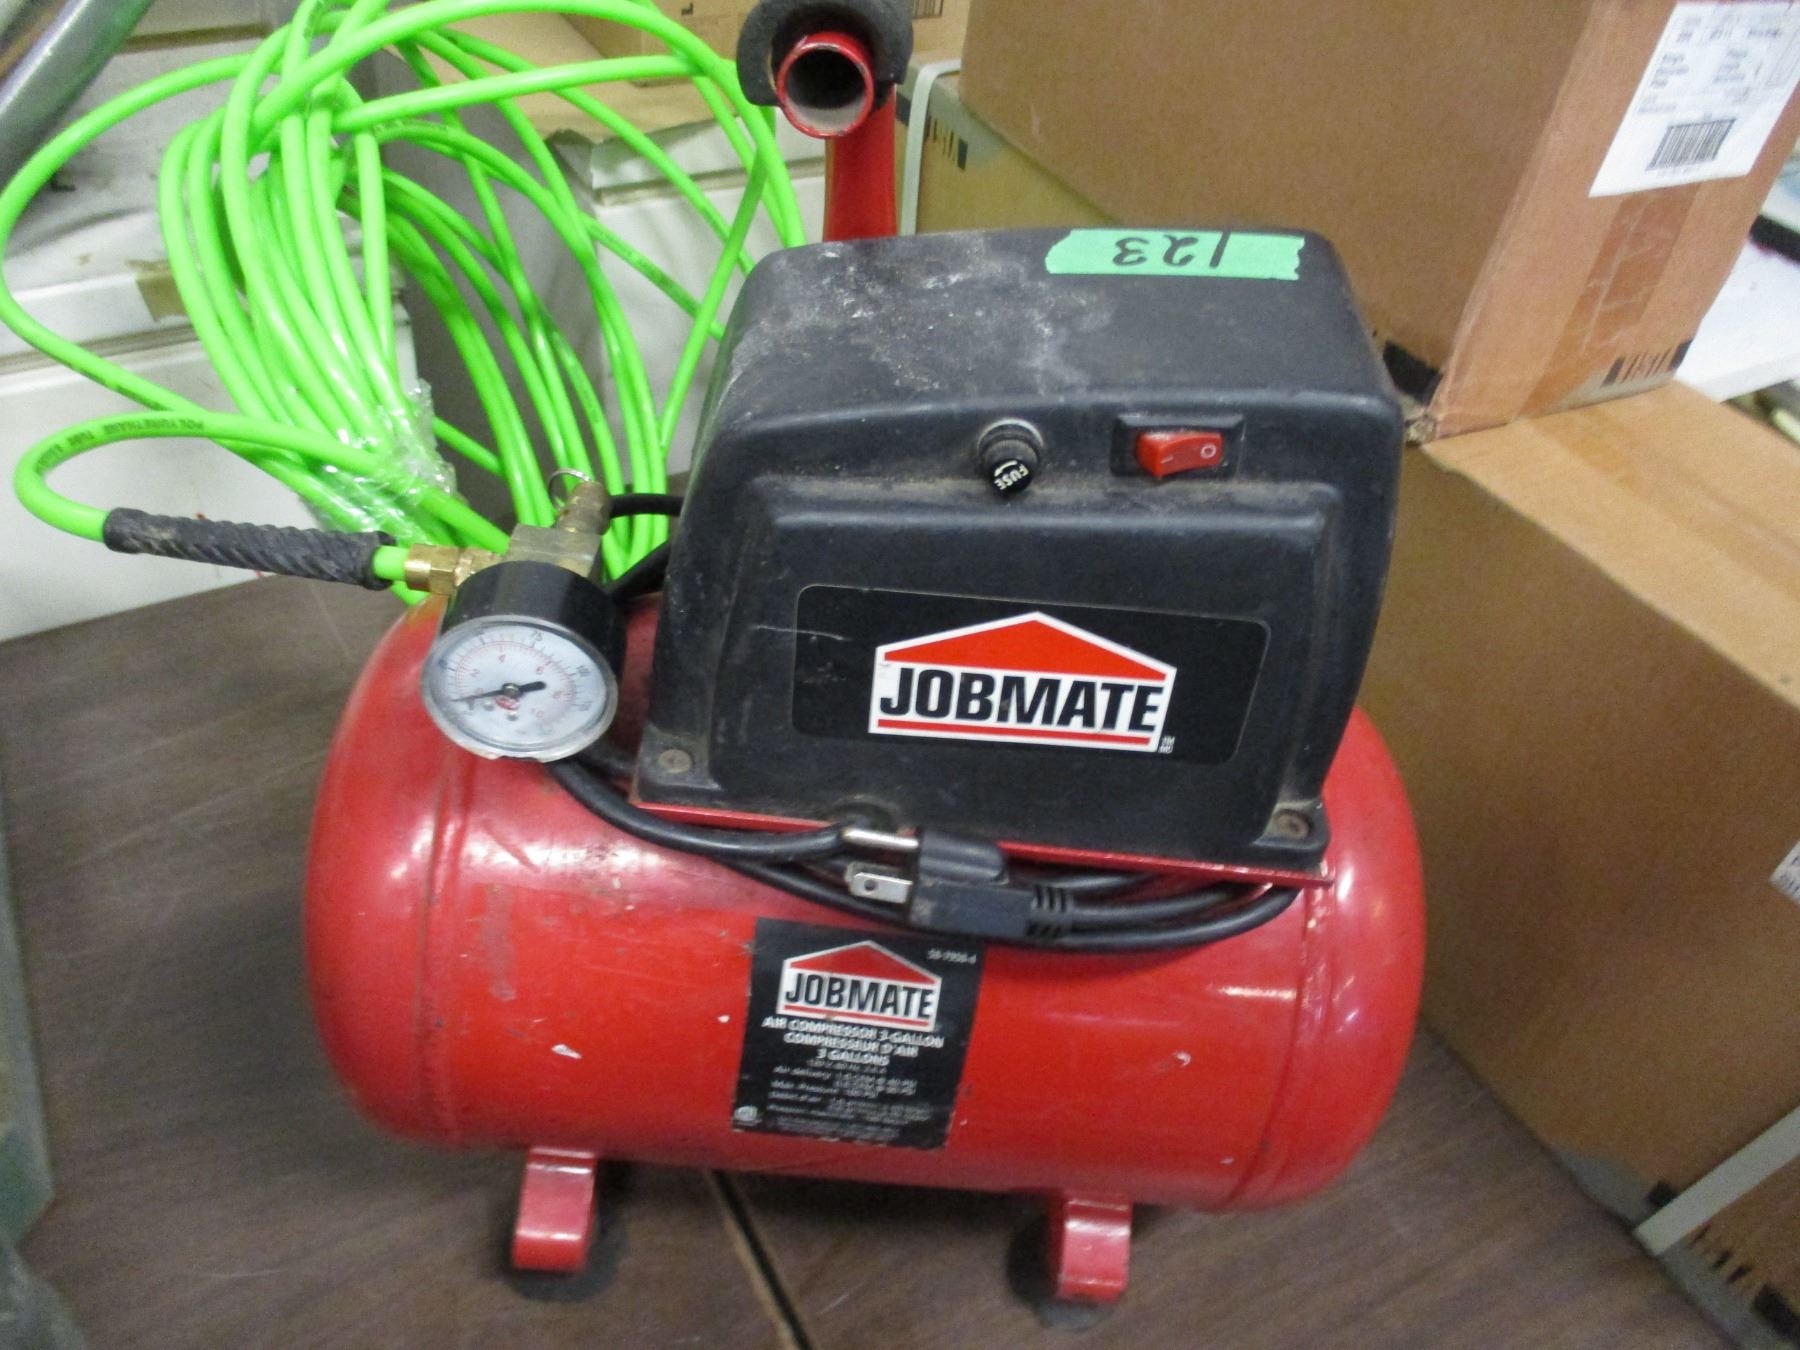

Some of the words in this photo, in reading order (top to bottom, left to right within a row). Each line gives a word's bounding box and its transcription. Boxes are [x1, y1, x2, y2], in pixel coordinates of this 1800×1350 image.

[1112, 231, 1232, 268] 123
[993, 463, 1029, 490] FUSE
[880, 667, 1164, 732] JOBMATE
[785, 973, 935, 1019] JOBMATE
[761, 1016, 787, 1029] AIR
[788, 1019, 878, 1041] COMPRESSOR
[783, 1032, 880, 1053] COMPRESSEUR
[880, 1043, 919, 1058] D'AIR
[816, 1048, 827, 1059] 3
[827, 1049, 890, 1066] GALLONS
